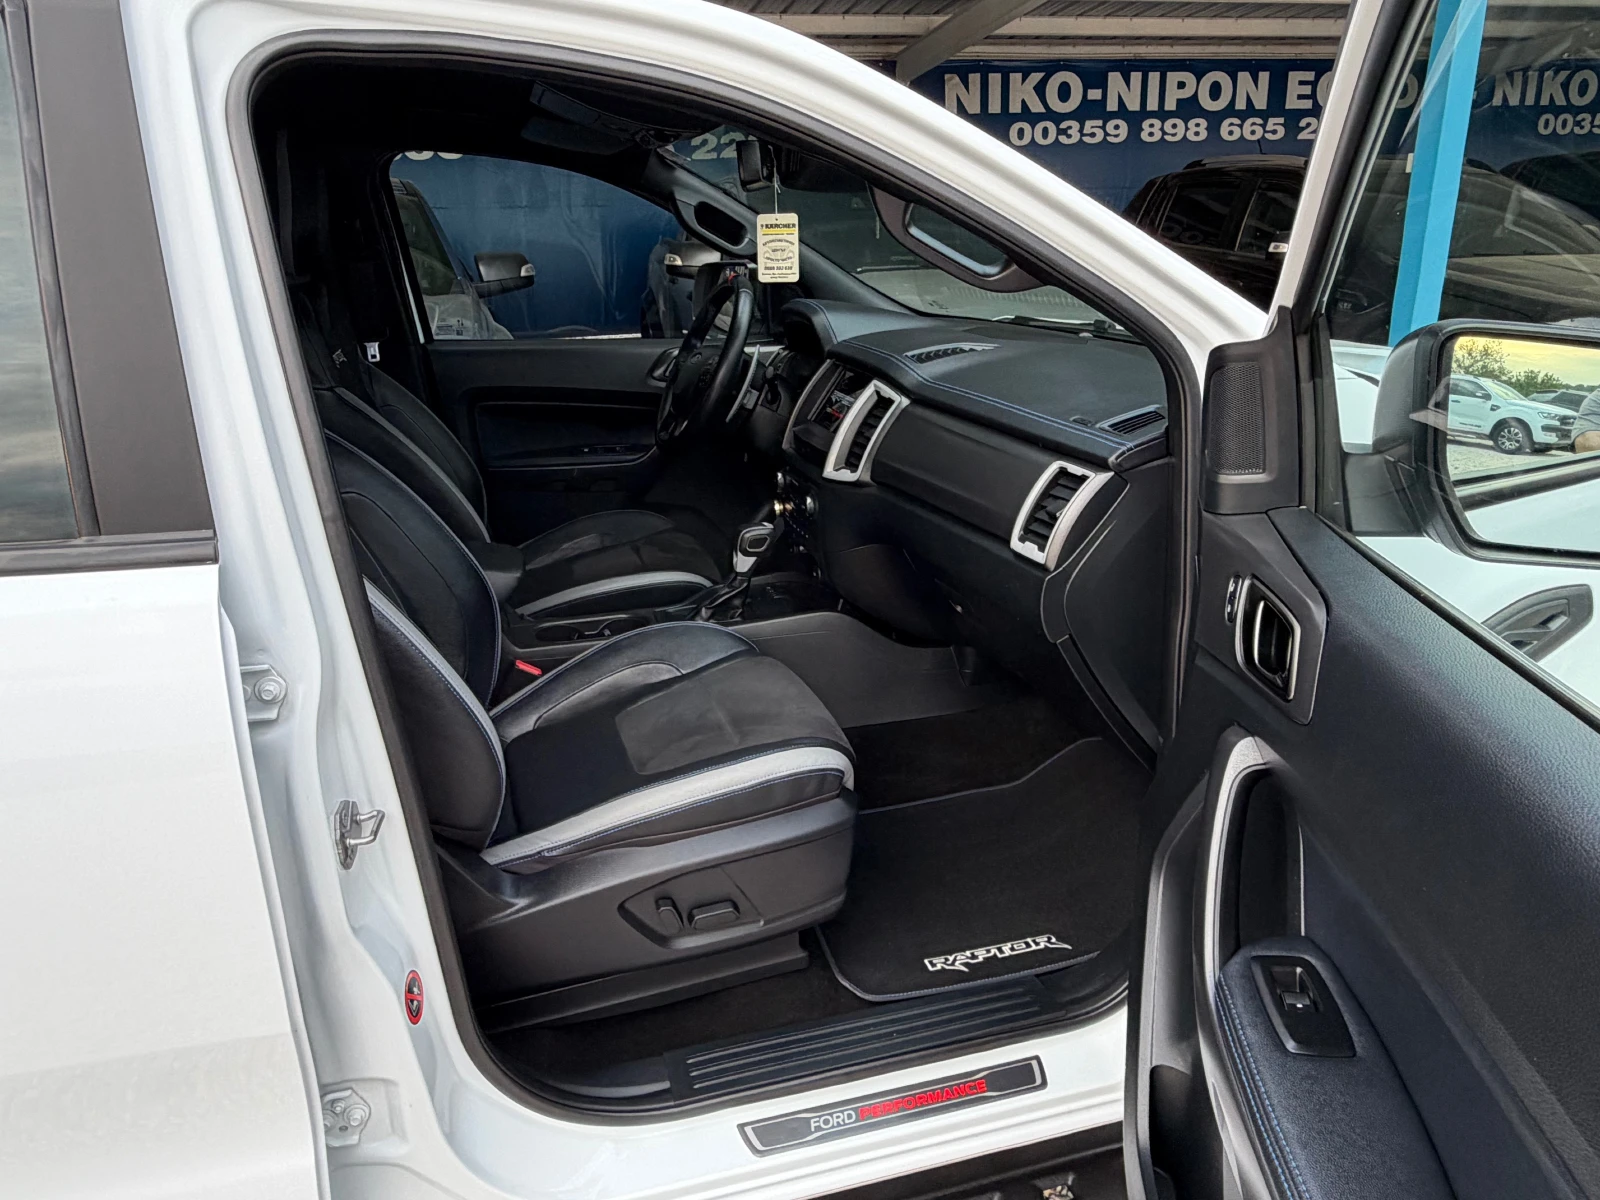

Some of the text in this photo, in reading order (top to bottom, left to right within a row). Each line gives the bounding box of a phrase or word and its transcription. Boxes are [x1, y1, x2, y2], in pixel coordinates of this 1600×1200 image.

[944, 70, 1270, 115] NIKO-NIPON
[1009, 116, 1319, 147] 00359 898 665 2
[924, 934, 1073, 972] RAPTOR
[810, 1078, 988, 1133] FORD PERFORMANCE
